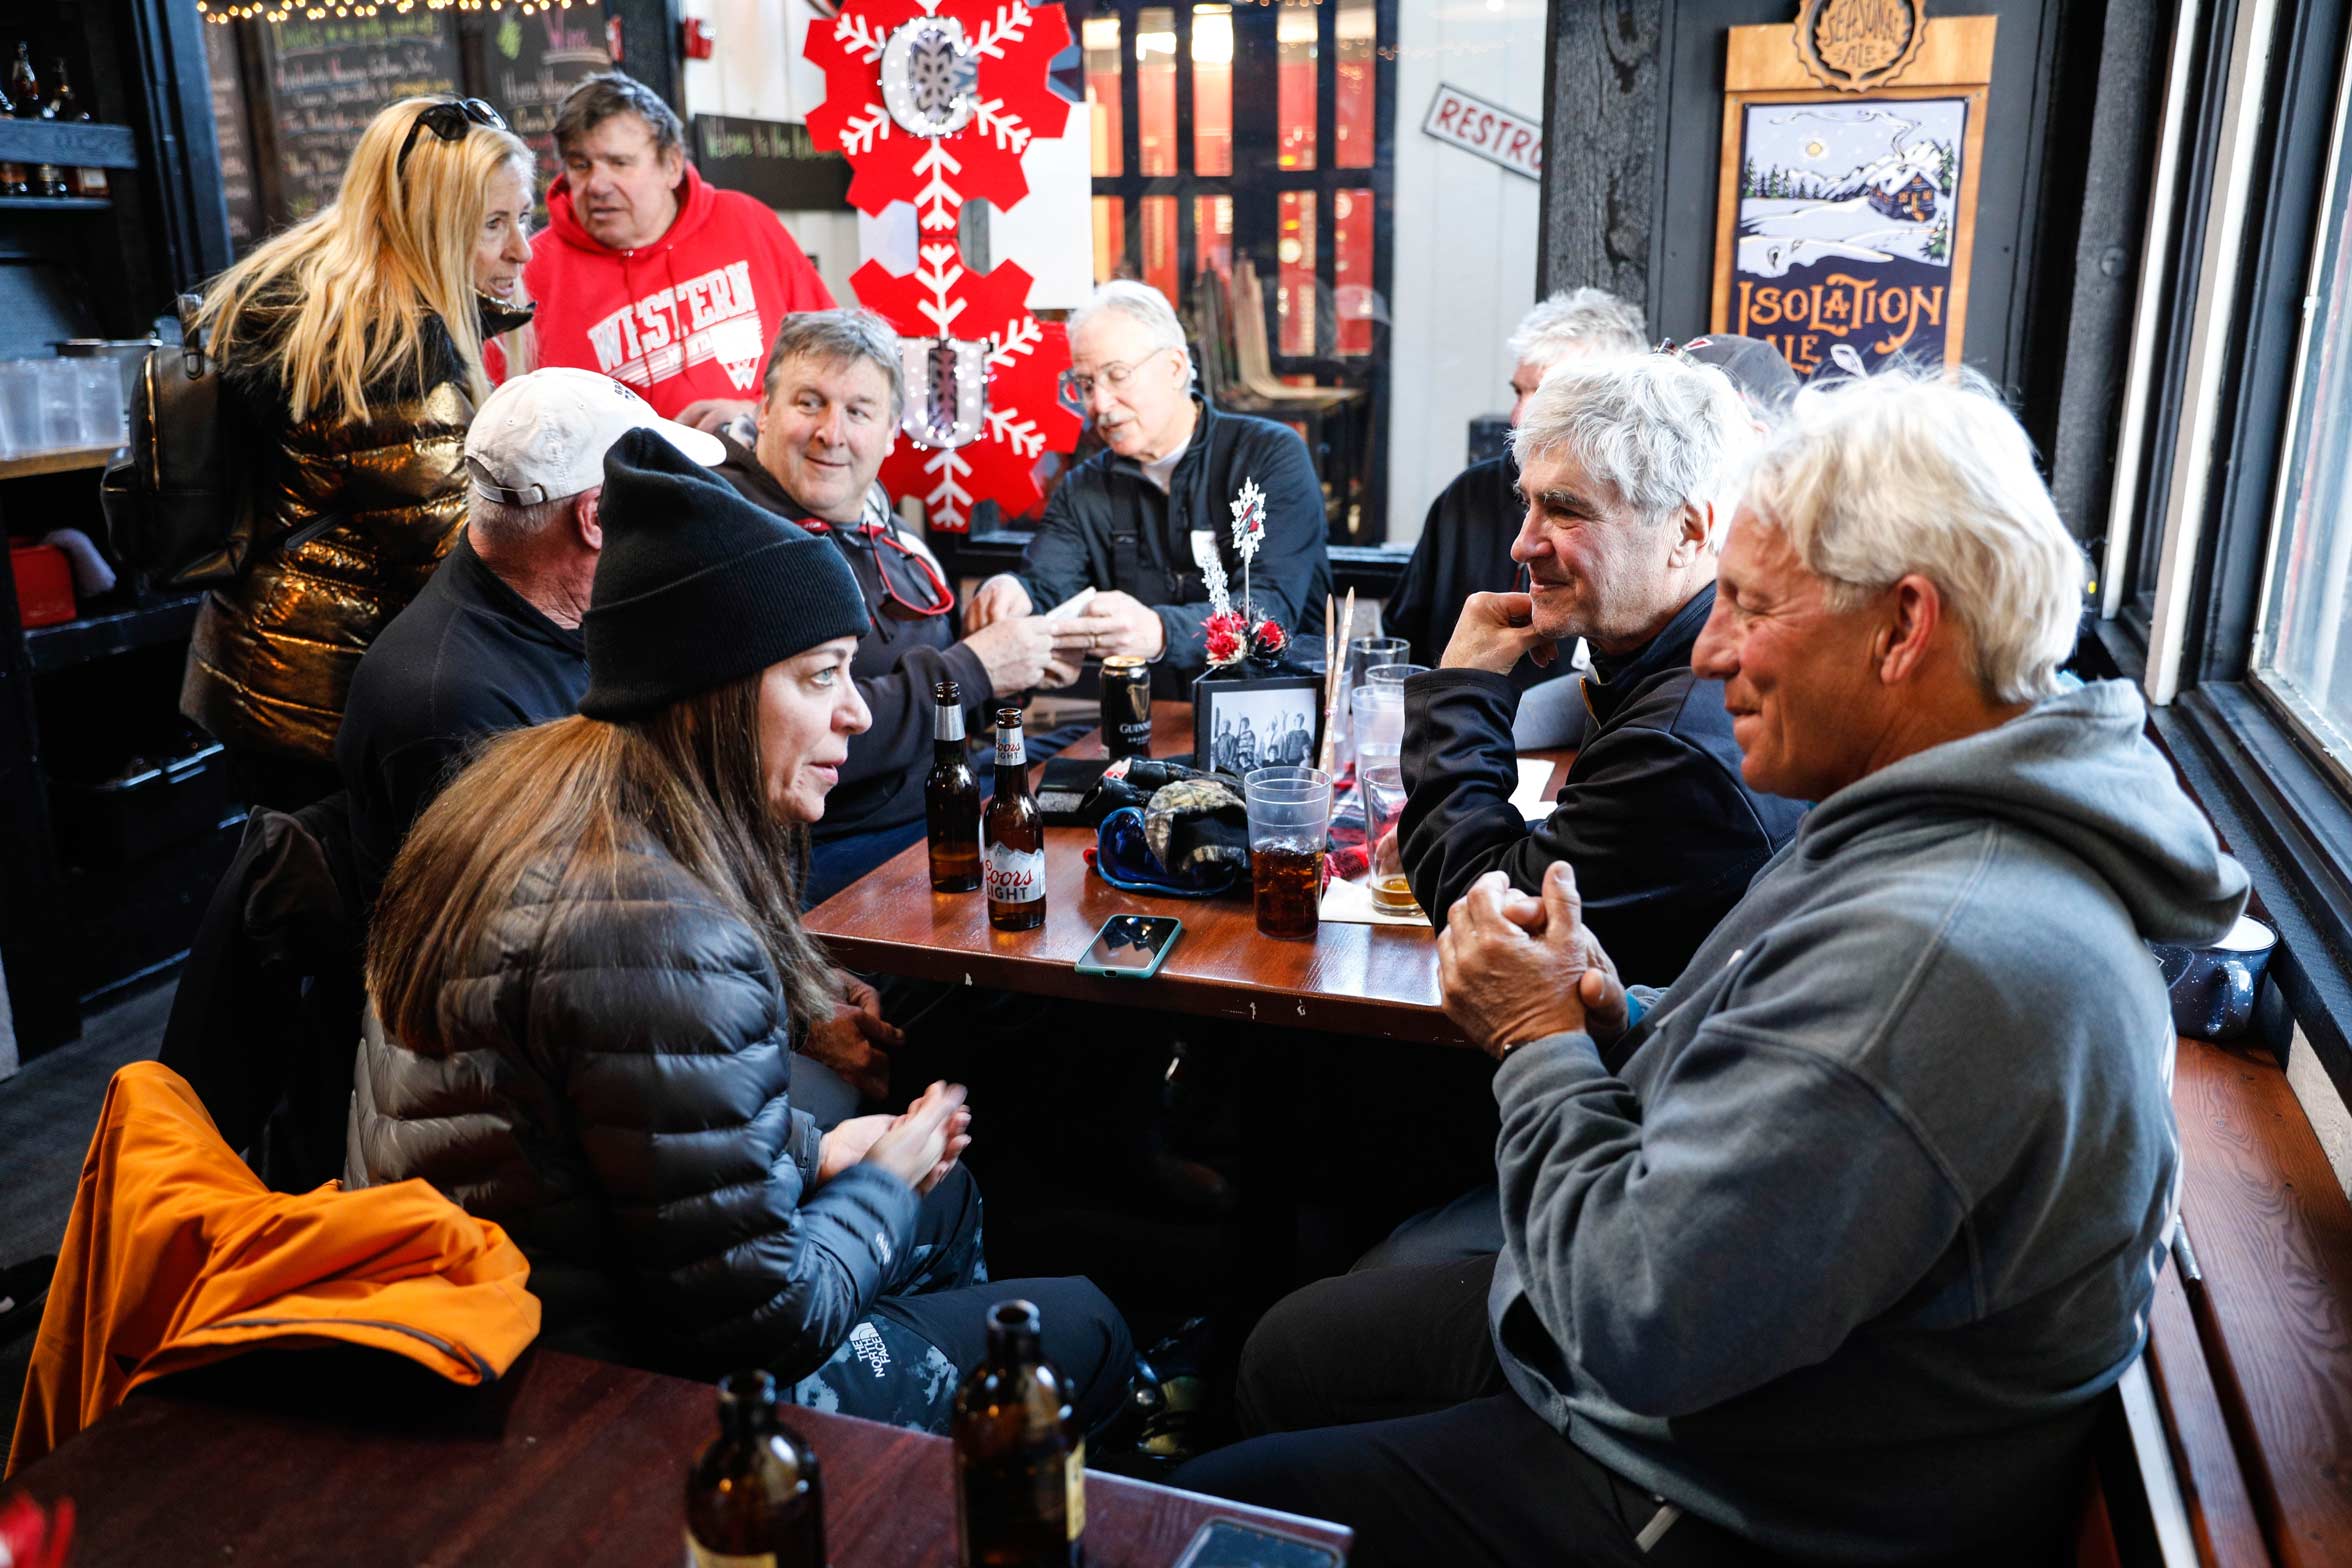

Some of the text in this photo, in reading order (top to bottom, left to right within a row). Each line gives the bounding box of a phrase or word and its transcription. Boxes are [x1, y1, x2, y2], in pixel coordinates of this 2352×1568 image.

[1842, 43, 1875, 68] ALE
[1738, 273, 1944, 354] ISOLATION
[851, 1340, 869, 1362] THE
[861, 1338, 886, 1378] NORTH
[871, 1335, 892, 1364] FACE
